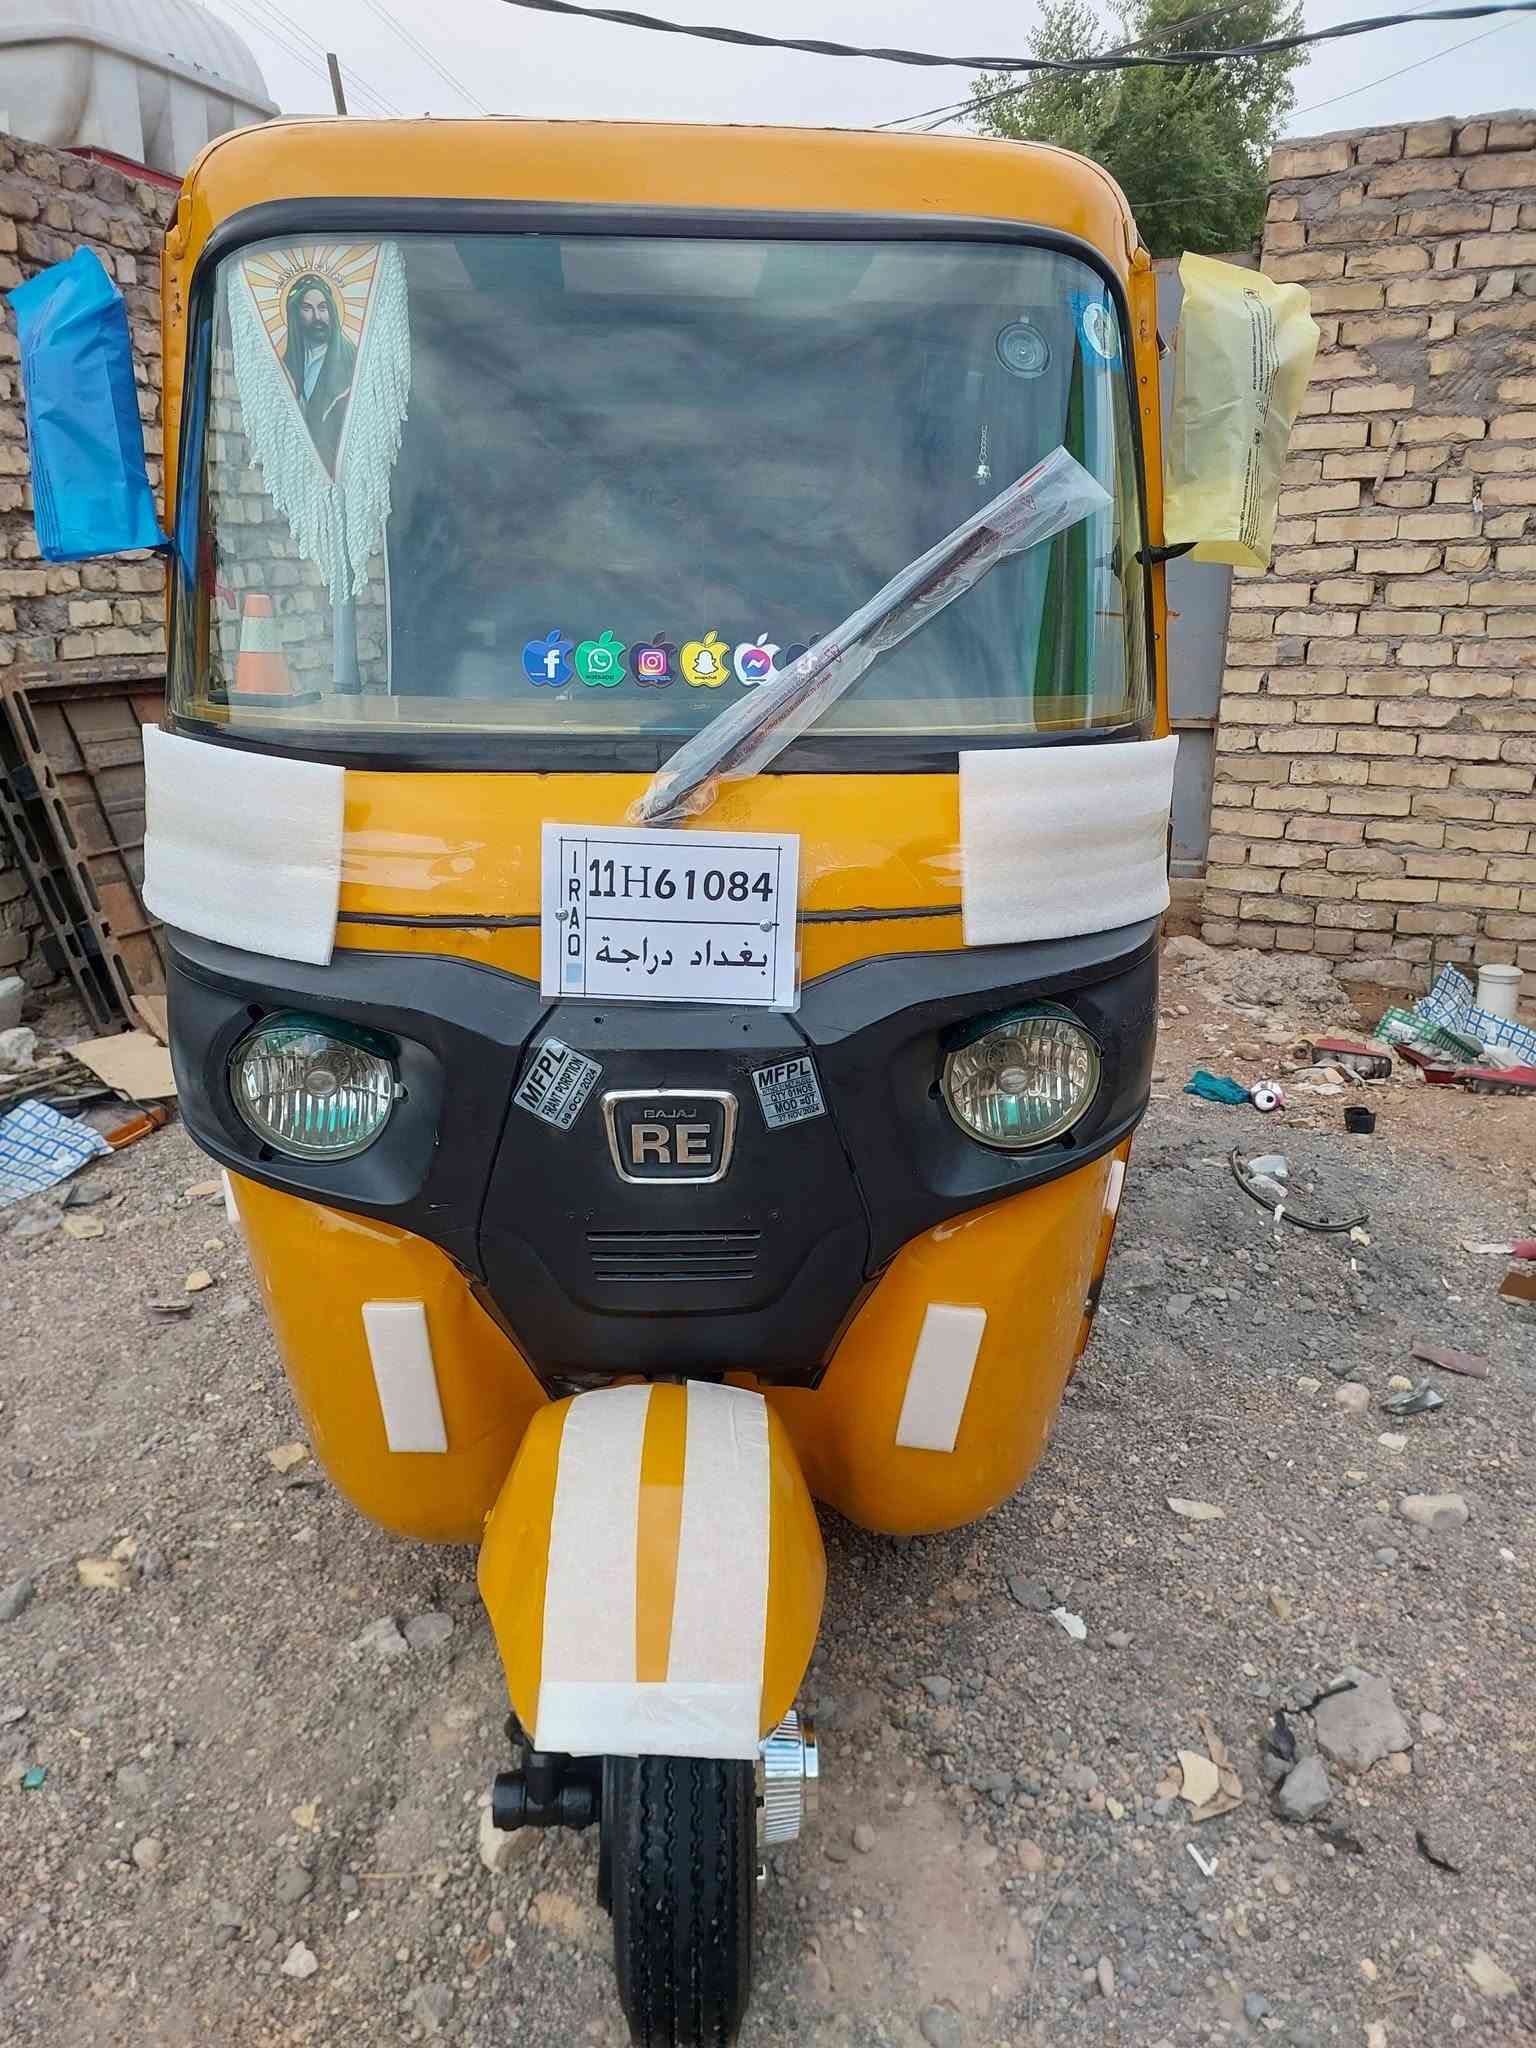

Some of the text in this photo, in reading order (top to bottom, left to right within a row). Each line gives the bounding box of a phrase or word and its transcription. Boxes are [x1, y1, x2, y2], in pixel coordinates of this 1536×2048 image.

[567, 850, 581, 957] IRAQ
[596, 936, 768, 976] بغداد دراجة
[520, 1048, 566, 1109] MFPL
[568, 1090, 585, 1111] OCT
[580, 1068, 598, 1090] 2024
[758, 1061, 810, 1088] MFPL
[643, 1108, 697, 1118] BAJAJ
[775, 1099, 798, 1113] MOD
[631, 1123, 712, 1164] RE
